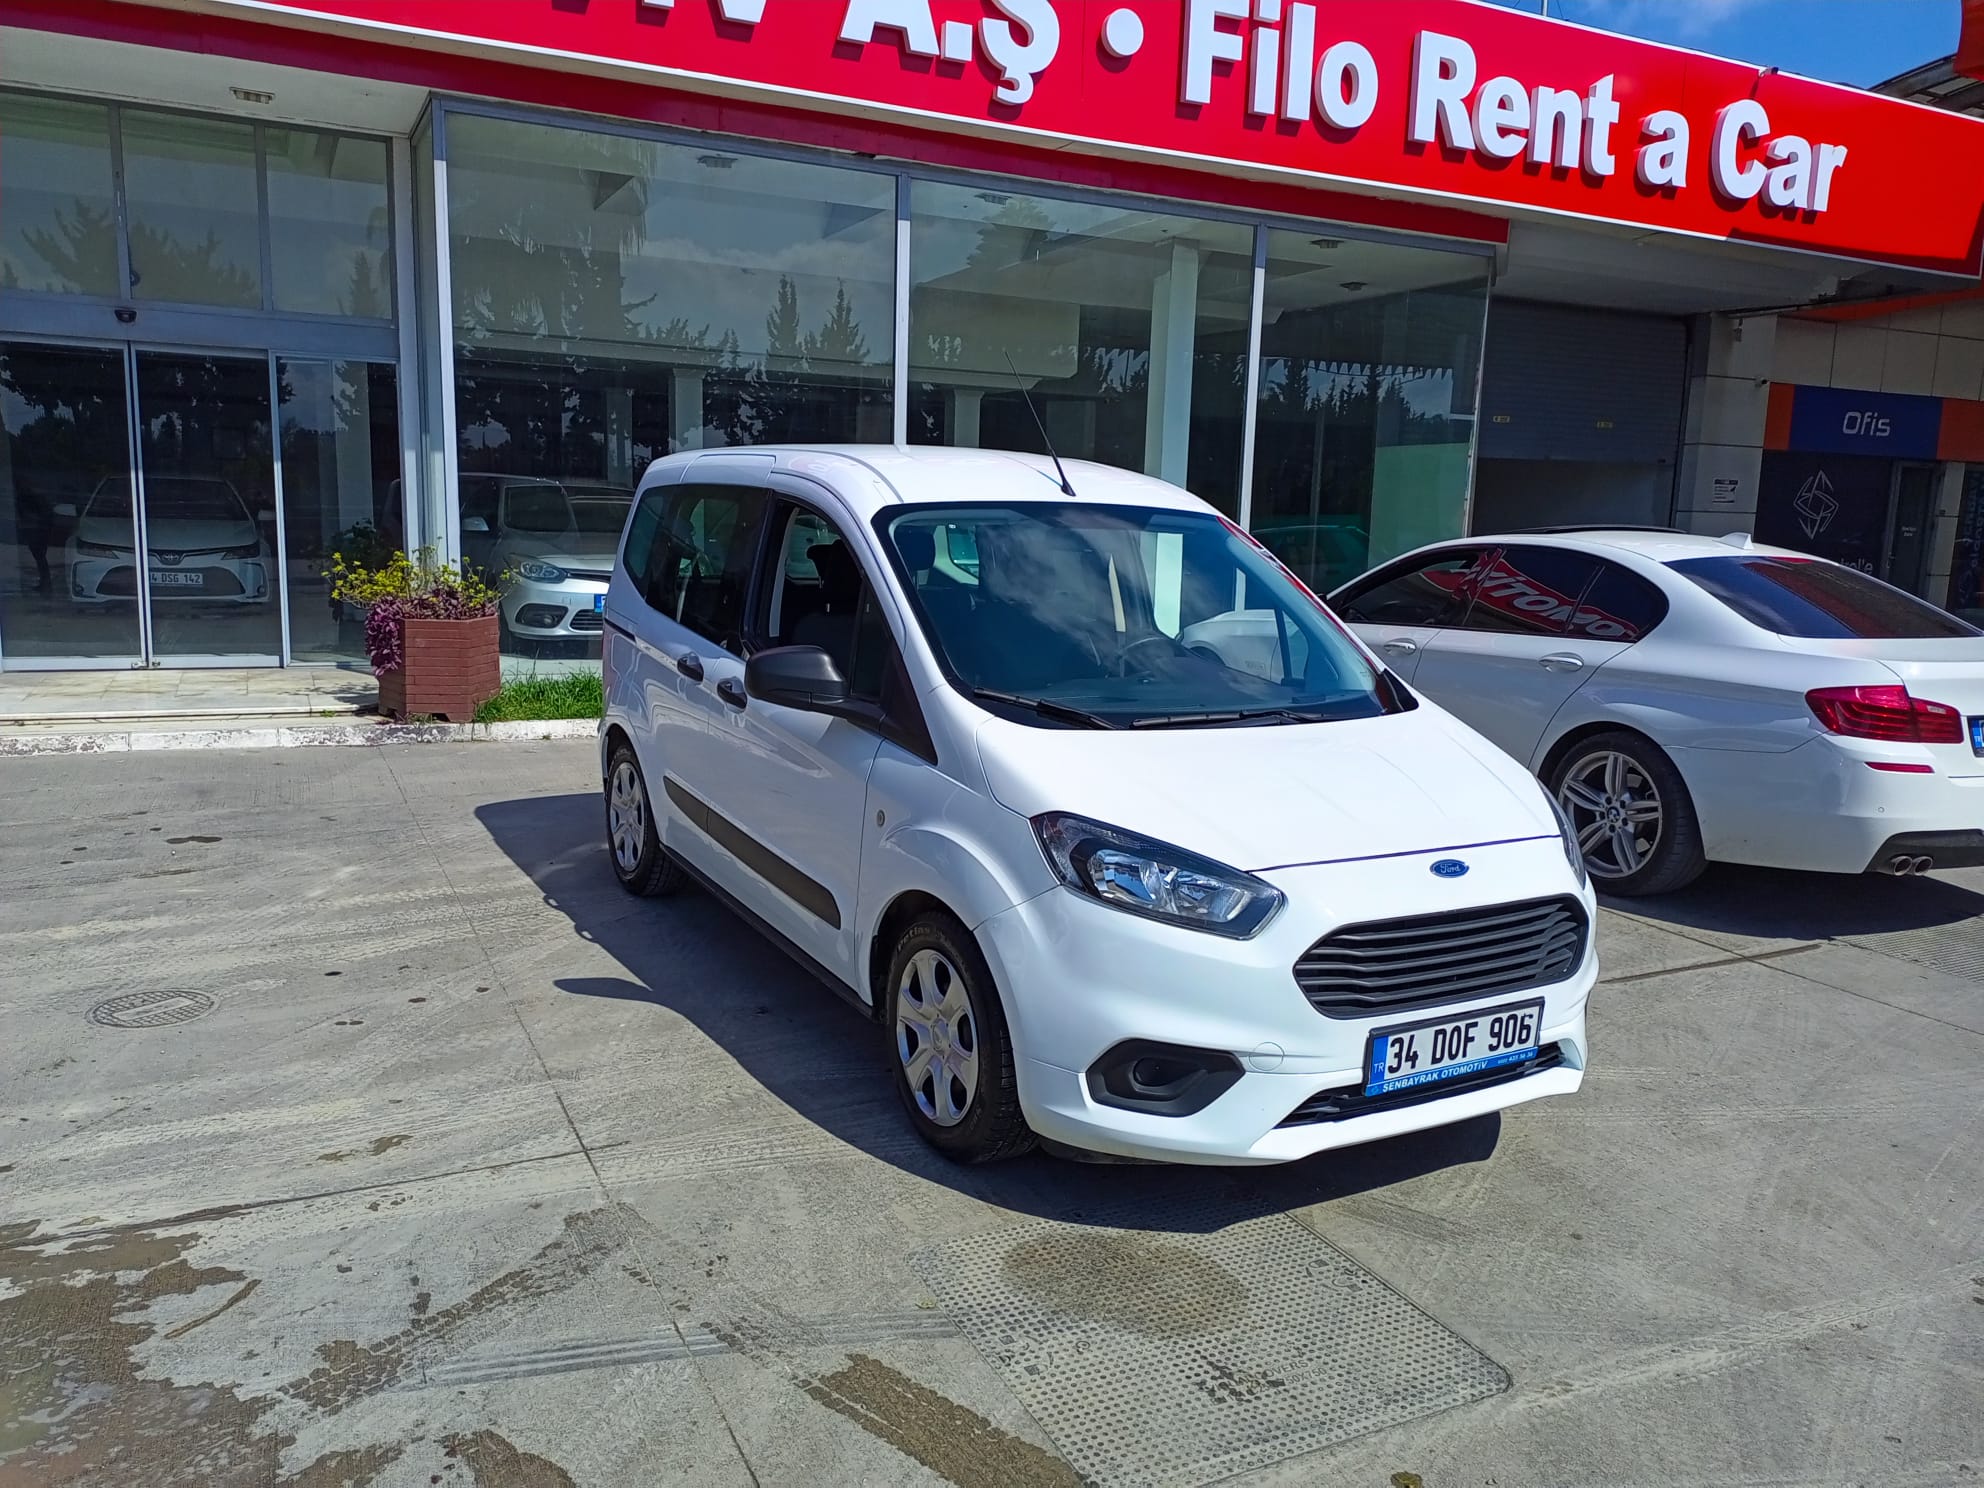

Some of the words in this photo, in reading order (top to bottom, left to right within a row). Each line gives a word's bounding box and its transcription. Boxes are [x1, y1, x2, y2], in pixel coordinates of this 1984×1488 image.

[1181, 0, 1379, 129] Filo
[1408, 30, 1620, 176] Rent
[1637, 110, 1690, 188] a
[1711, 99, 1848, 212] Car
[1843, 411, 1890, 437] Ofis
[1387, 1034, 1419, 1074] 34
[1430, 1021, 1479, 1065] DOF
[1487, 1012, 1534, 1052] 906
[1373, 1062, 1385, 1074] TR
